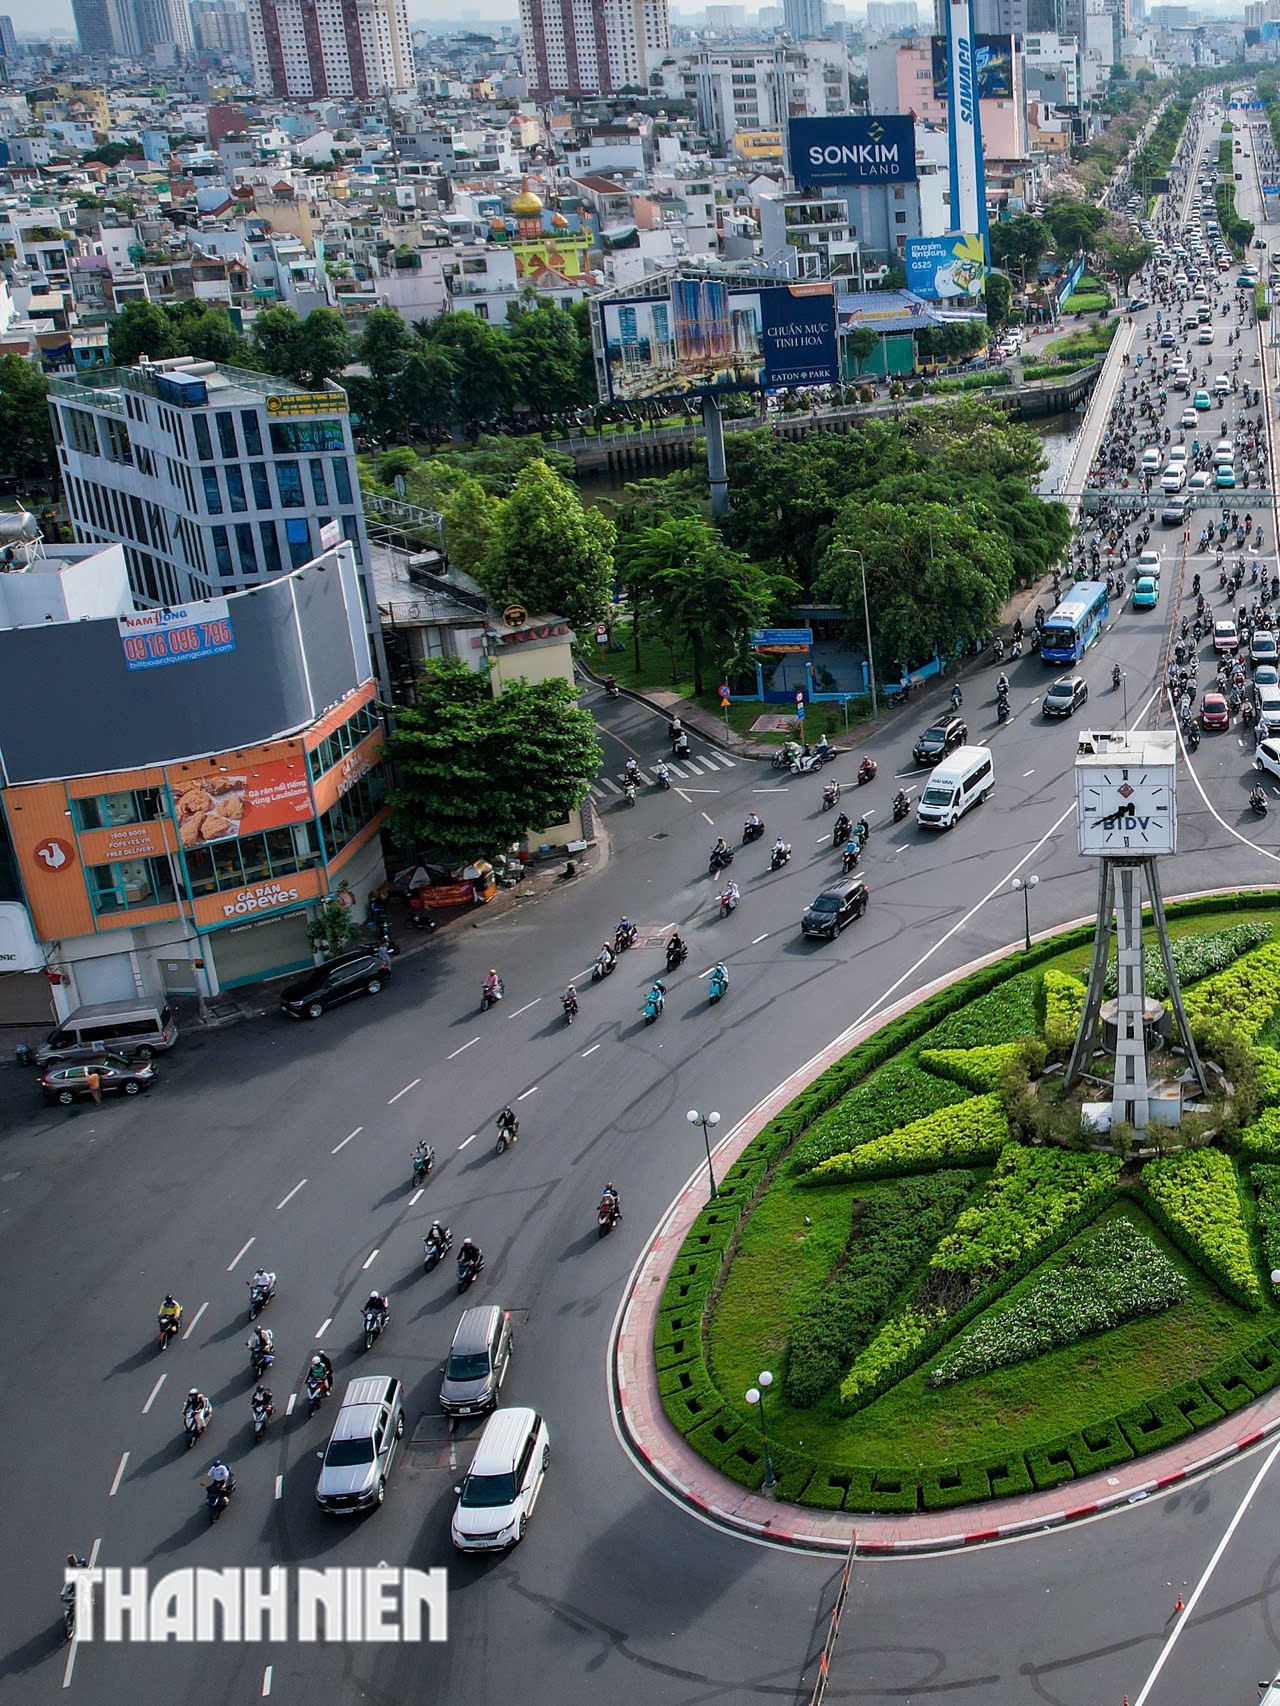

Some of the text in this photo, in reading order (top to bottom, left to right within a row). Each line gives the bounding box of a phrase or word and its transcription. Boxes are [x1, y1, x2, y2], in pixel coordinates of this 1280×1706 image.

[957, 37, 973, 126] SAWACO
[809, 143, 899, 165] SONKIM
[860, 163, 900, 176] LAND
[912, 261, 932, 270] GS25
[767, 322, 829, 336] CHUẨN MỰC
[774, 336, 823, 348] TINH HOA
[771, 369, 831, 382] EATON PARK
[126, 616, 152, 628] NAM
[124, 620, 232, 661] 0916 095 795
[129, 643, 233, 670] billboardquangcao.com
[248, 789, 260, 798] Gà
[271, 788, 308, 801] Louisiana
[1103, 816, 1150, 830] BIDV
[237, 883, 281, 902] GÀ RÁN
